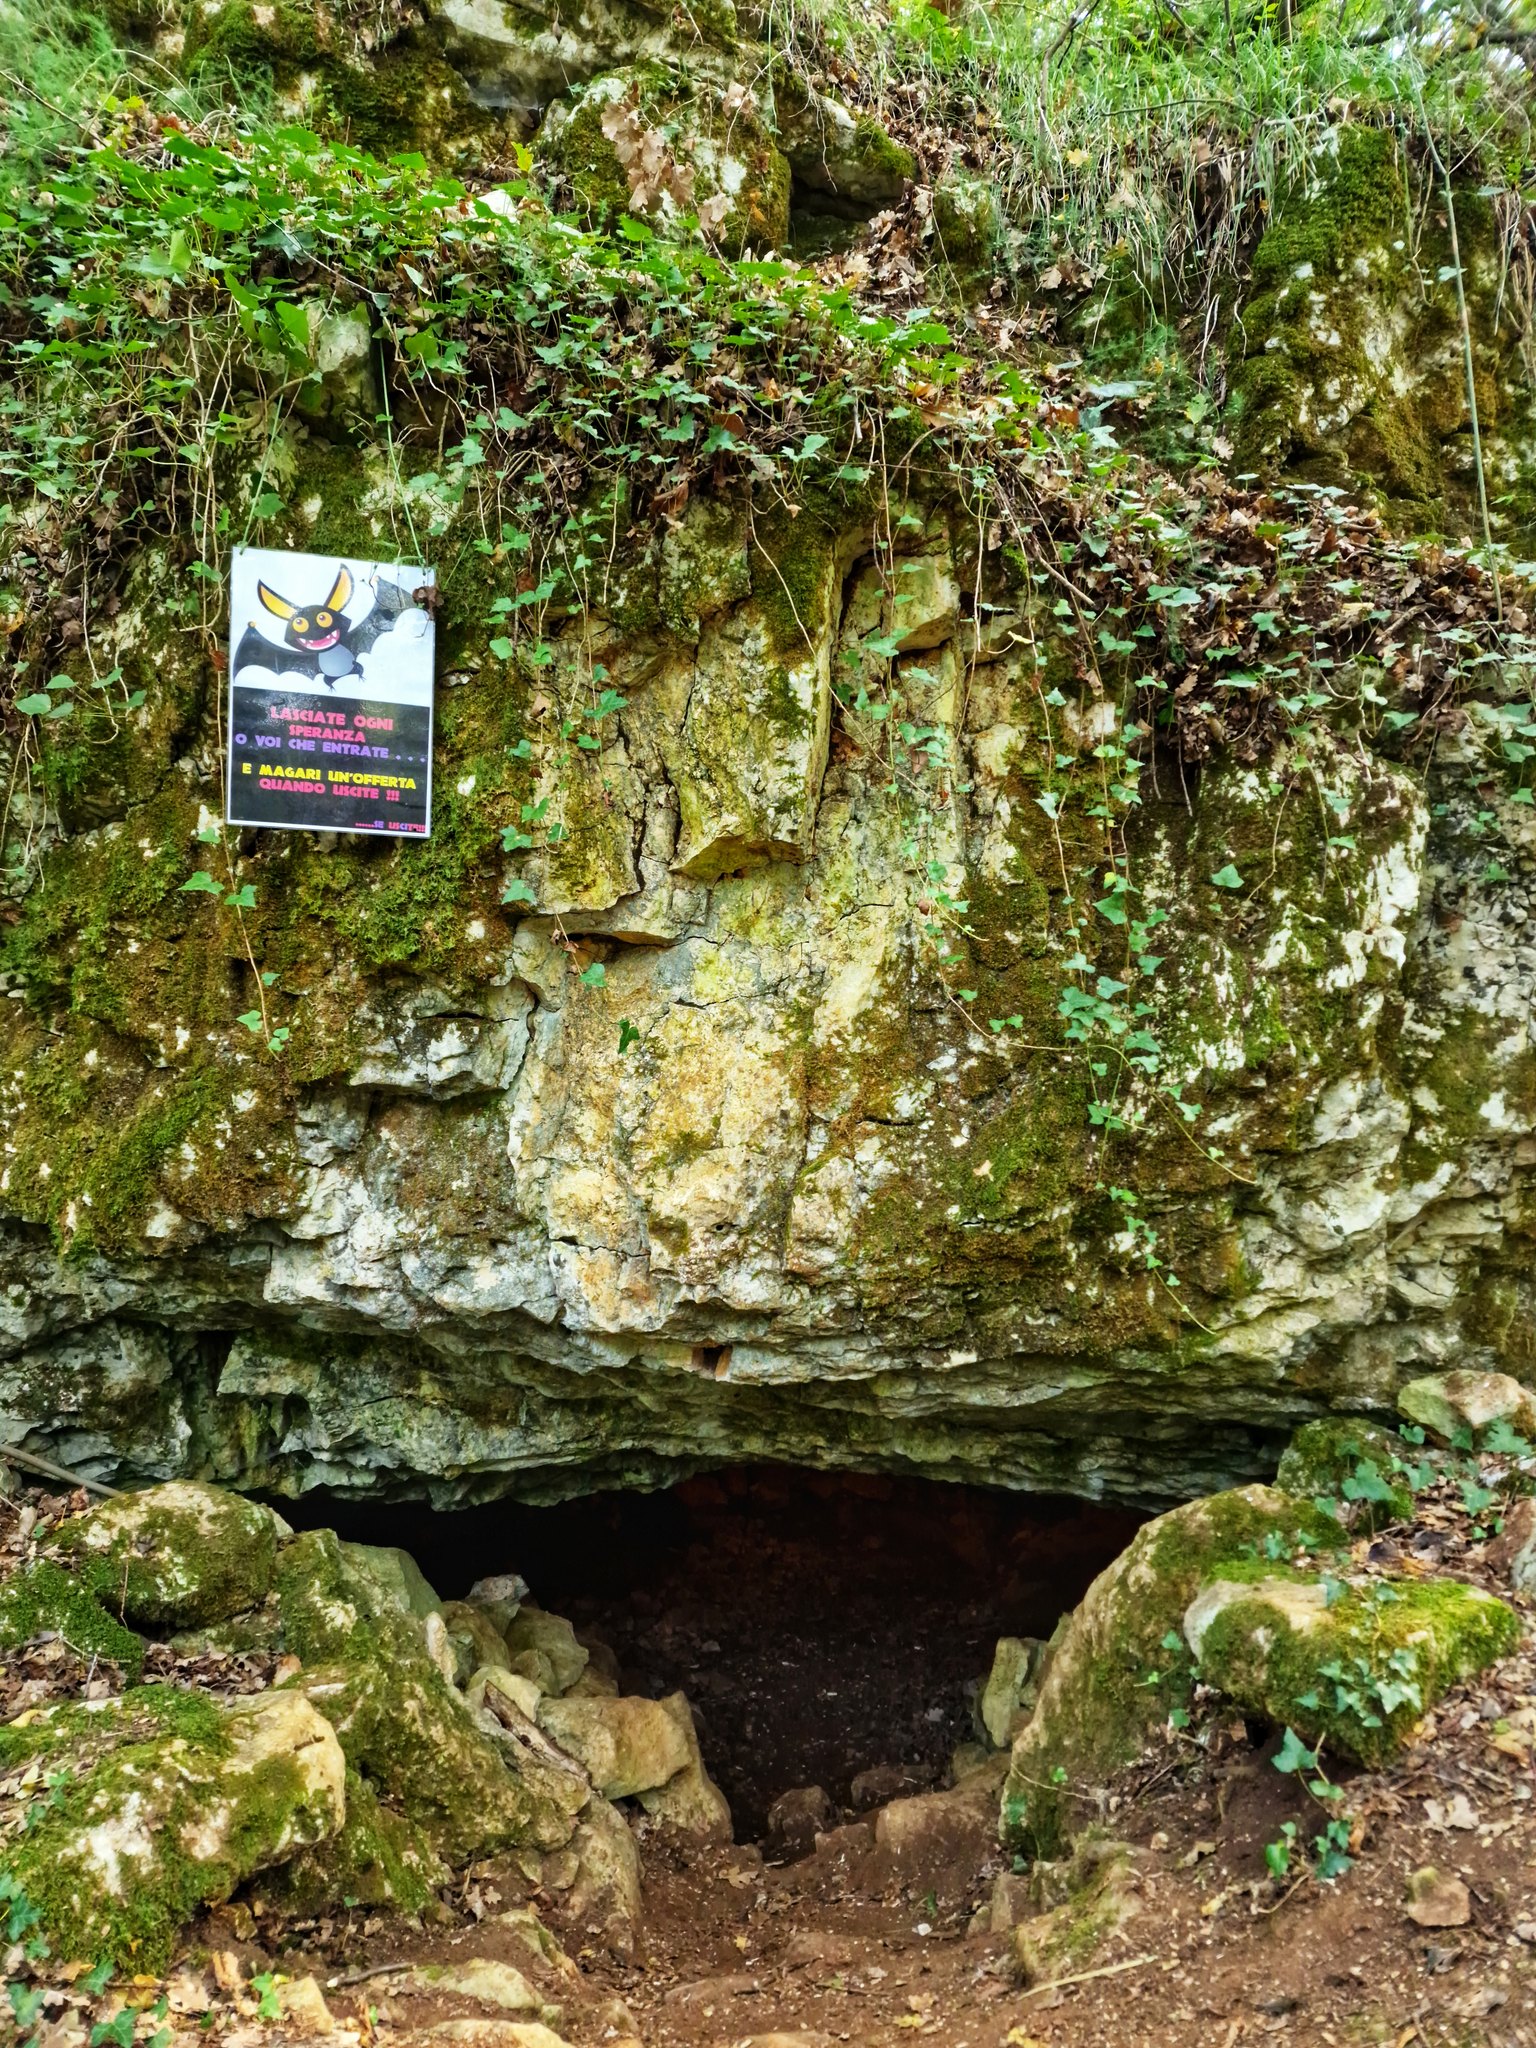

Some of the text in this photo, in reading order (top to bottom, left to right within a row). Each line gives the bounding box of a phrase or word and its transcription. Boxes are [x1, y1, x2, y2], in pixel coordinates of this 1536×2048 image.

[270, 706, 394, 731] LASCIATE OGNI
[235, 733, 248, 745] O
[255, 735, 281, 748] VOI
[288, 738, 316, 752] CHE
[322, 742, 389, 758] ENTRATE
[288, 724, 366, 743] SPERANZA
[242, 762, 417, 790] E MAGARI UN'OFFERTA
[259, 778, 400, 802] QUANDO USCITE !!!
